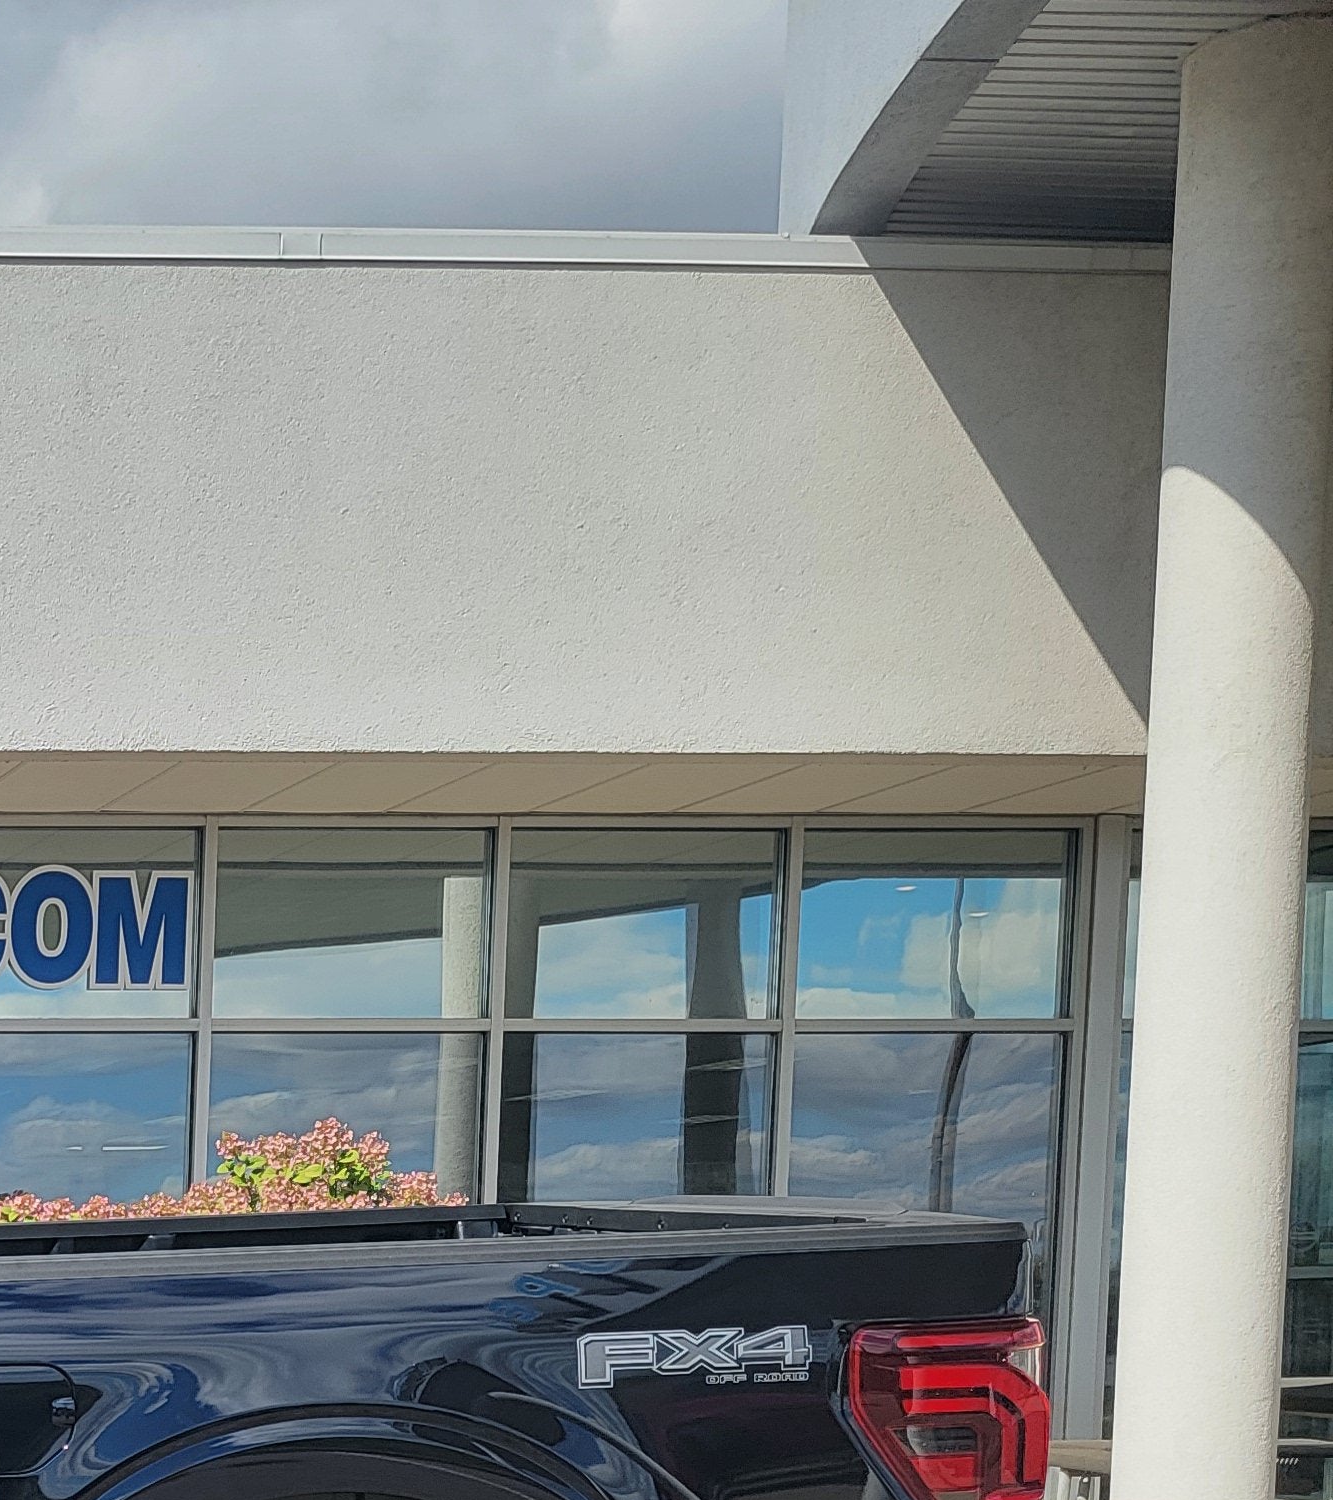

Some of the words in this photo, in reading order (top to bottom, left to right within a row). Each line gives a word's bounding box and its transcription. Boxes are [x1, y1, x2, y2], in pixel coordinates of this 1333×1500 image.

[577, 1325, 812, 1389] FX4
[706, 1373, 748, 1385] OFF
[754, 1371, 810, 1383] ROAD
